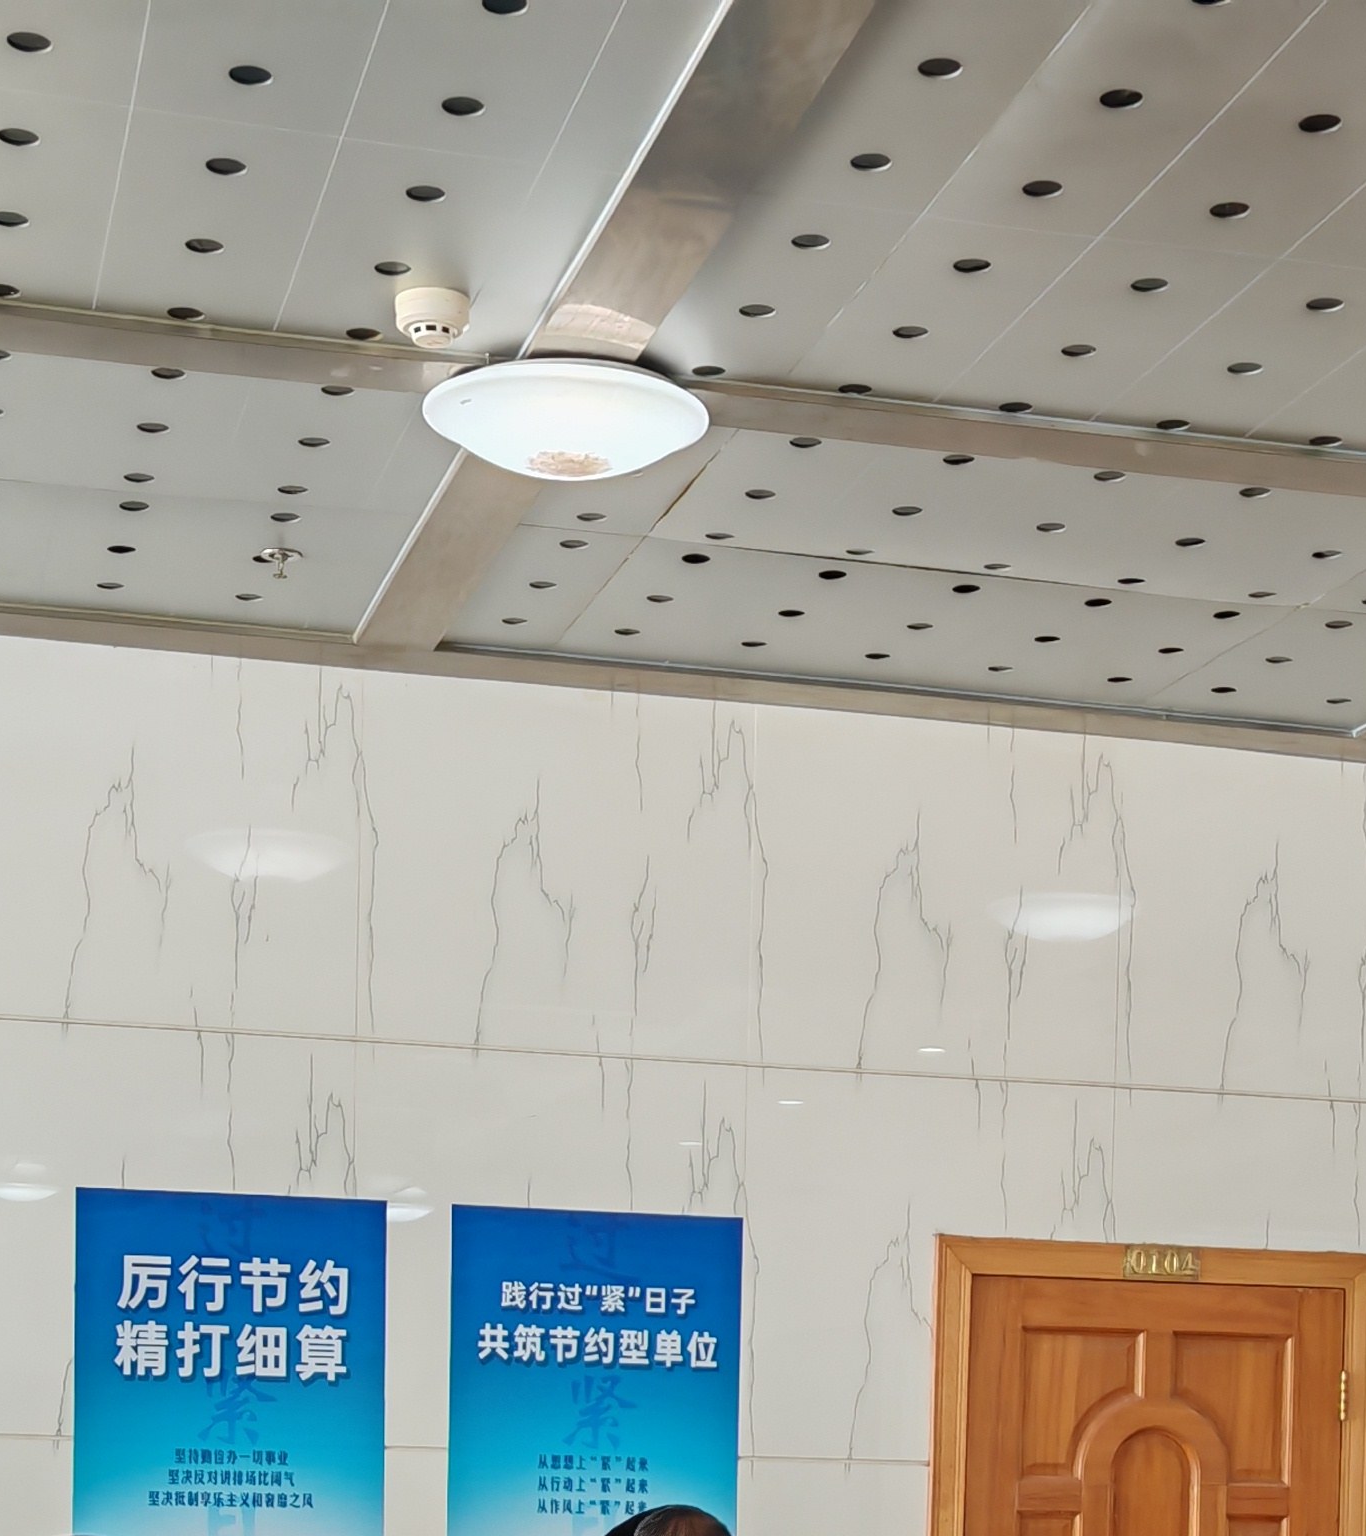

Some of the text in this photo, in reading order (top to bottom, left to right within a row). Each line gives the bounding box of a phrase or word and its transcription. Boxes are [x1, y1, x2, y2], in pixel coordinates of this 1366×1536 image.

[117, 1253, 350, 1315] 厉行节约
[501, 1279, 697, 1316] 践行过“紧”日子
[115, 1320, 349, 1381] 精打细算
[477, 1322, 719, 1370] 共筑节约型单位
